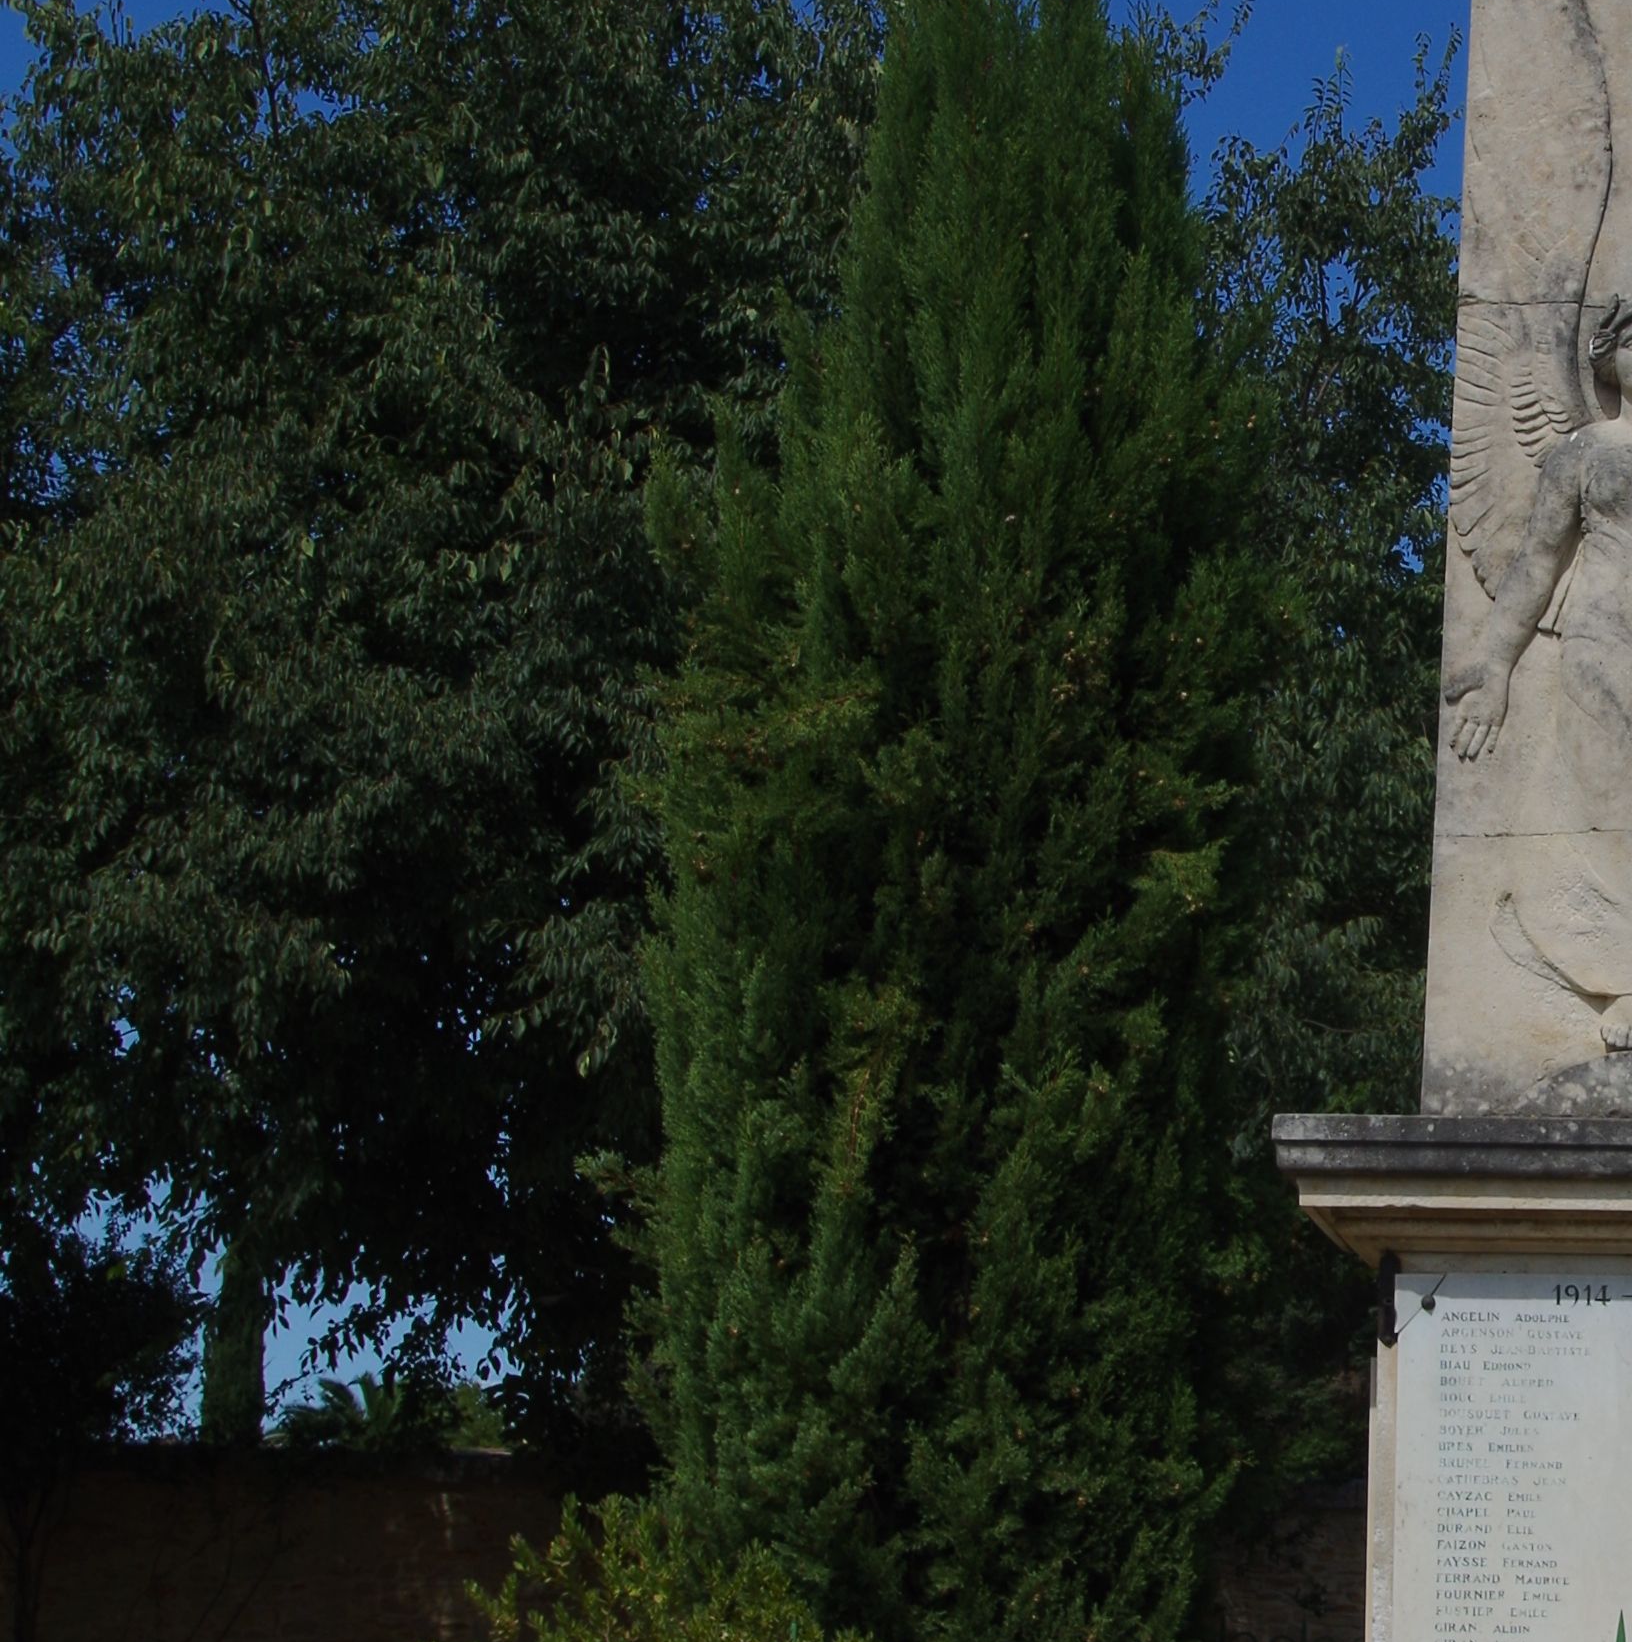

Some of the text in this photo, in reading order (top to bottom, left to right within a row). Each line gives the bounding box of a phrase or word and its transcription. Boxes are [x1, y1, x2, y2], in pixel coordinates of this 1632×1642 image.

[1553, 1285, 1611, 1307] 1914
[1441, 1312, 1569, 1323] ANGELIN ADOLPHE
[1528, 1329, 1583, 1340] GUSTAVE
[1440, 1360, 1531, 1371] BIAU EDMOND
[1523, 1410, 1580, 1421] GUSTAVE
[1500, 1426, 1540, 1436] JULES
[1488, 1442, 1535, 1453] EMILIEN
[1506, 1459, 1562, 1469] FERNAND
[1533, 1477, 1566, 1486] JEAN
[1437, 1491, 1542, 1502] CAYZAC EMILE
[1437, 1507, 1536, 1518] CHAPEL PAUL
[1437, 1524, 1534, 1535] DURAND ELIE
[1437, 1540, 1552, 1551] FAIZON GASTON
[1437, 1557, 1557, 1568] FAYSSE FERNAND
[1436, 1573, 1570, 1585] FERRAND MAURICE
[1436, 1590, 1561, 1602] FOURNIER EMILE
[1510, 1607, 1547, 1618] EMILE
[1435, 1622, 1530, 1634] GIRAN ALBIN
